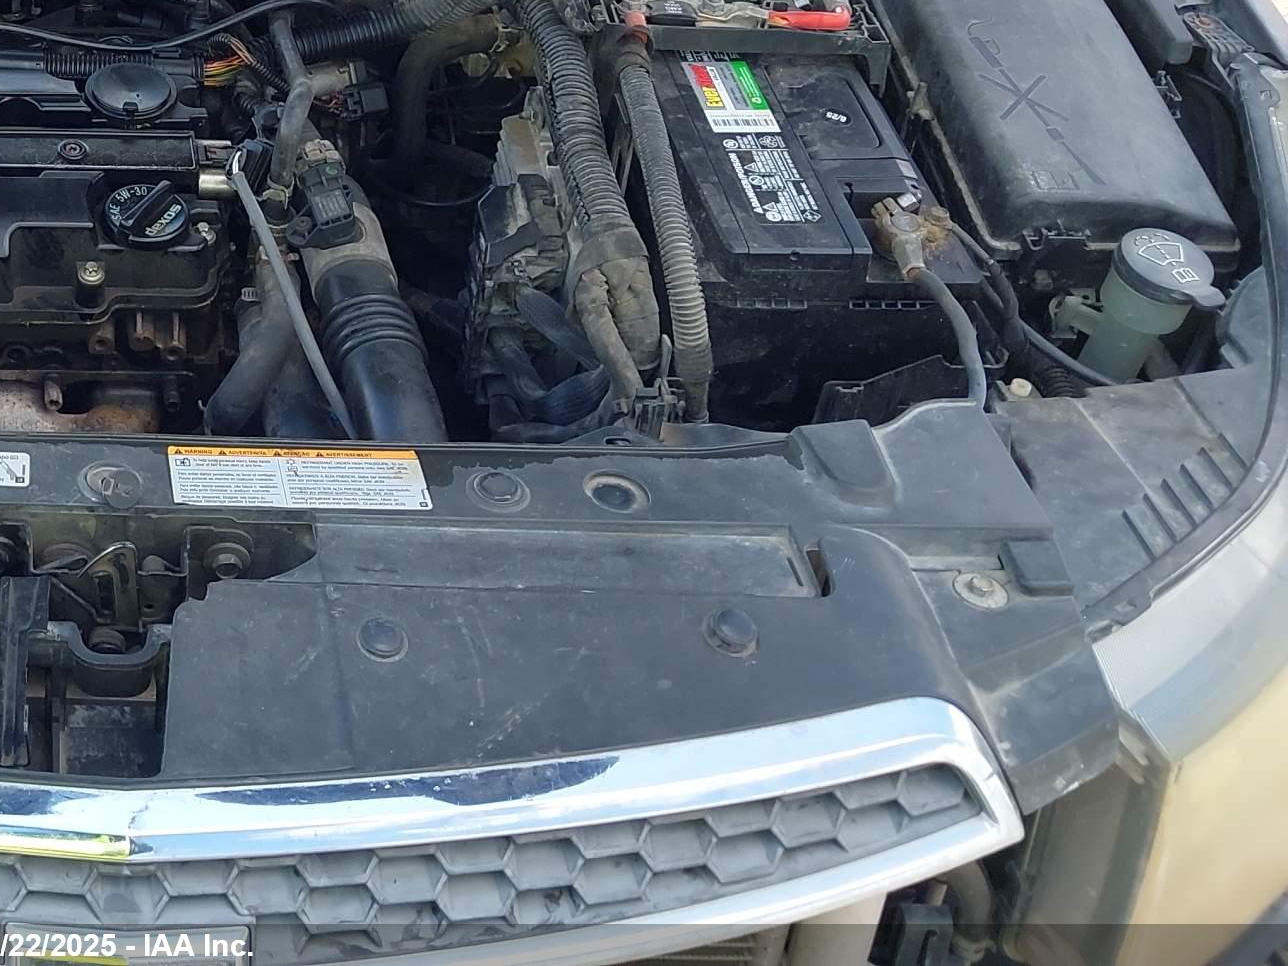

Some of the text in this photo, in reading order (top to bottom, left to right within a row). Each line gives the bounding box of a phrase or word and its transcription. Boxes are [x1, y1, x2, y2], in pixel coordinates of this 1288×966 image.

[109, 186, 148, 222] SAE 5W-30
[144, 203, 182, 236] dexos
